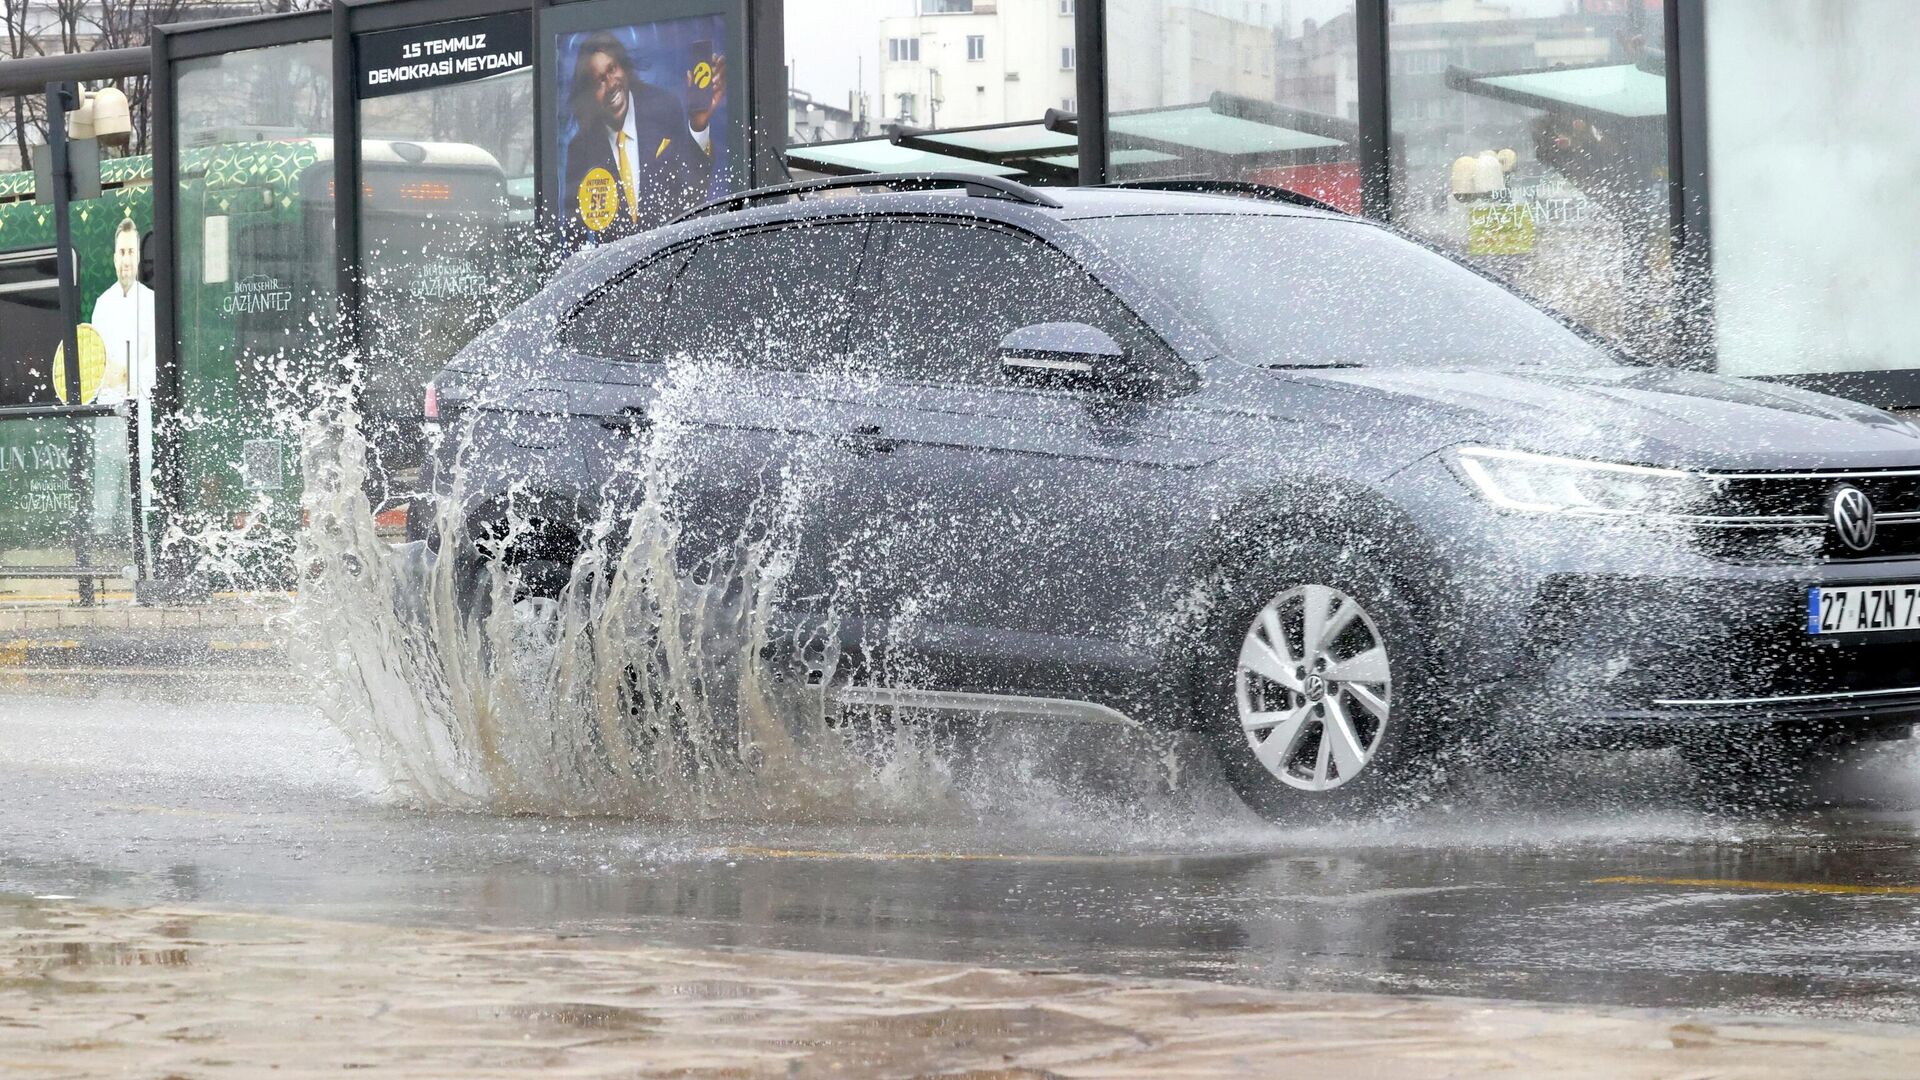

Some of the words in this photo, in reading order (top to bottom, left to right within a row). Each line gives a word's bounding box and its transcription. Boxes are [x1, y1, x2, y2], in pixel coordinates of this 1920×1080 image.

[402, 42, 421, 59] 15
[424, 33, 486, 56] TEMMUZ
[368, 57, 453, 85] DEMOKRASİ
[456, 51, 523, 74] MEYDANI
[1821, 592, 1848, 631] 27
[1857, 589, 1896, 629] AZN
